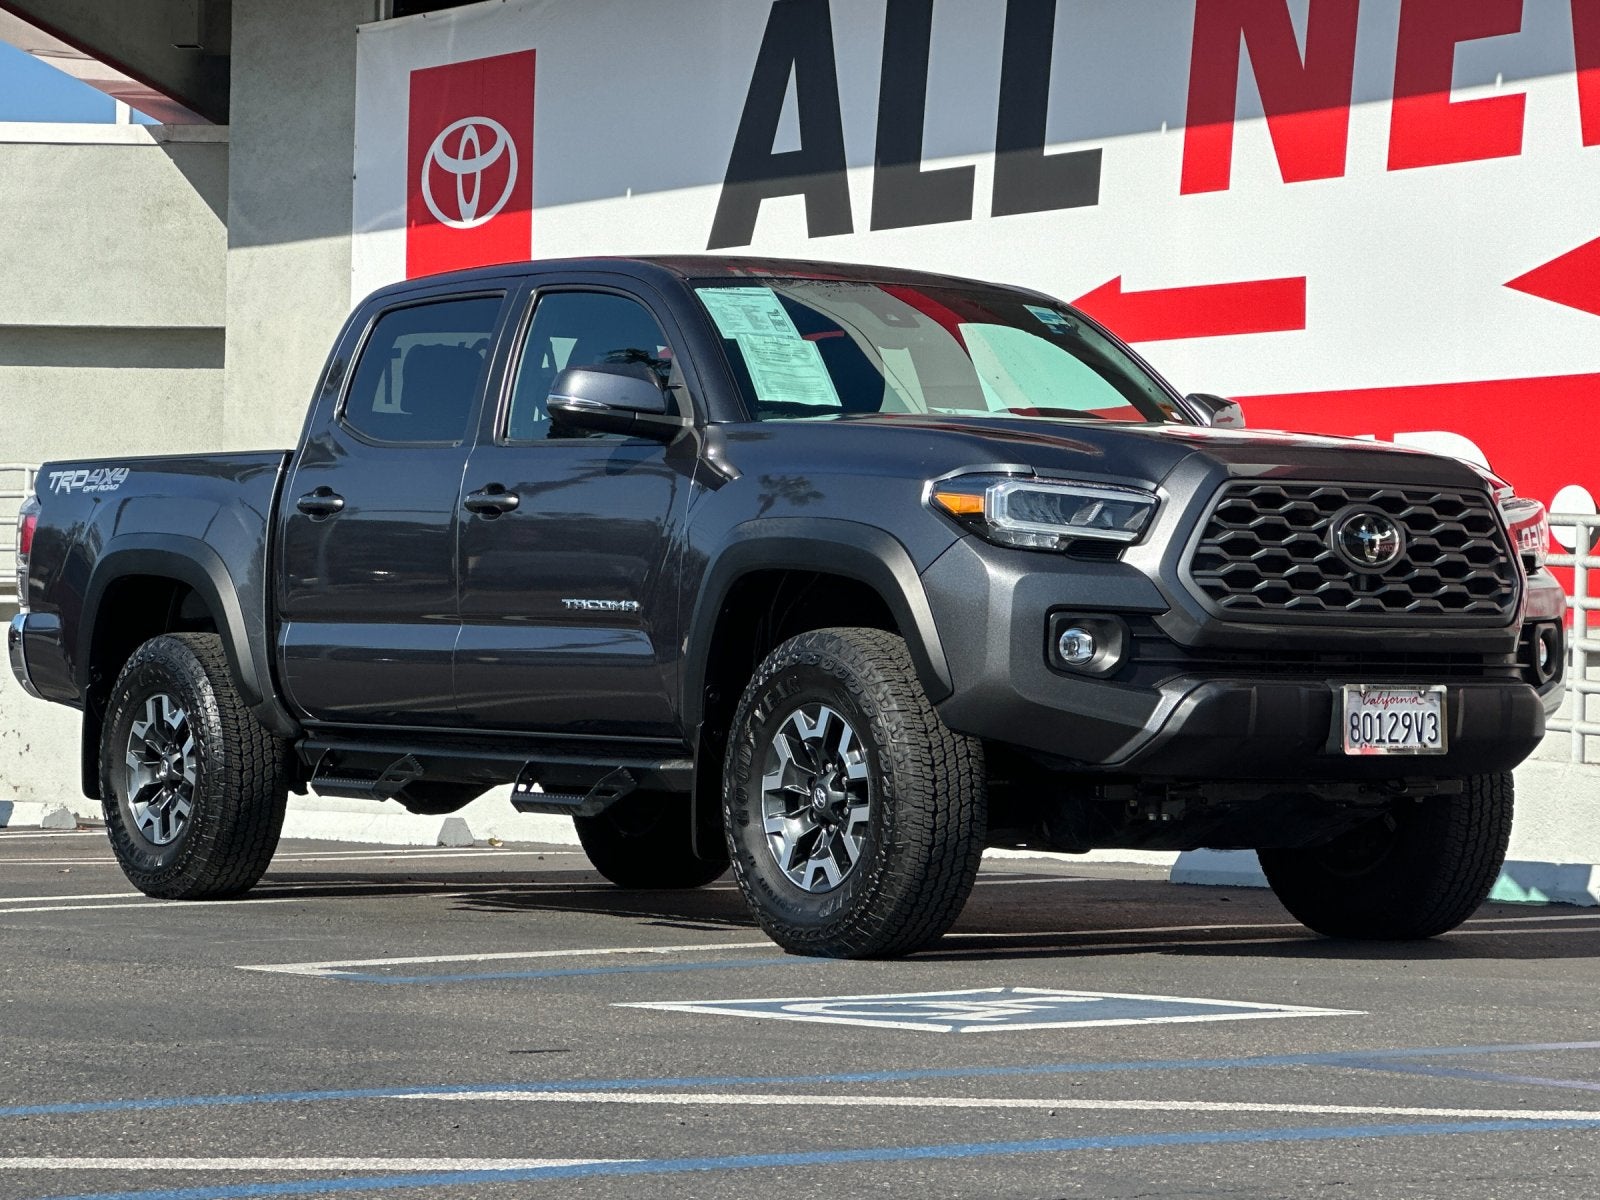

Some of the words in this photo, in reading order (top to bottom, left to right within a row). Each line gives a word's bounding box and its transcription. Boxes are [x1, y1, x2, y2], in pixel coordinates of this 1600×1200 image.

[707, 0, 1103, 250] ALL
[1180, 0, 1600, 196] NE
[561, 598, 640, 611] TACOMA
[1361, 690, 1426, 710] California
[1350, 712, 1438, 743] 80129V3
